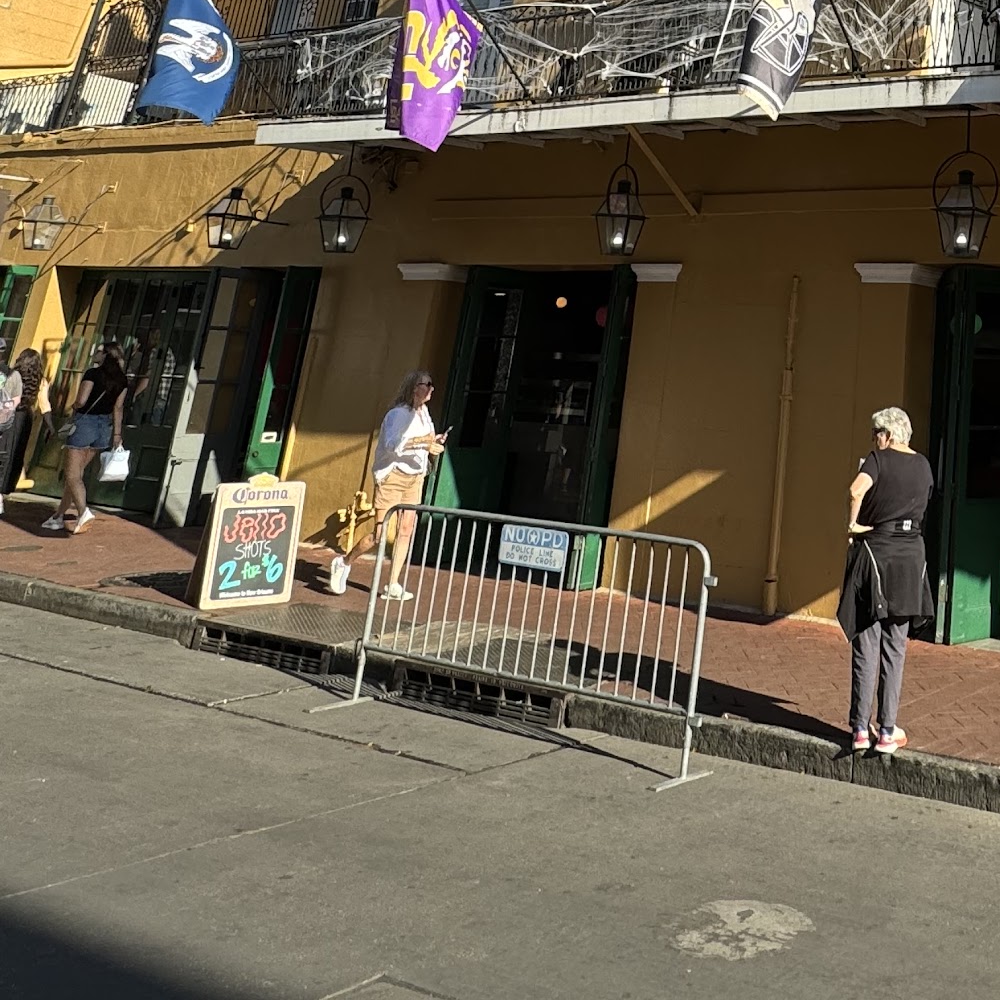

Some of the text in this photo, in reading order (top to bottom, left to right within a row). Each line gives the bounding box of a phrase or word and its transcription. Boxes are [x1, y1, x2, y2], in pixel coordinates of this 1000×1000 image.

[232, 487, 288, 504] Corona
[233, 540, 272, 560] SHOTS
[511, 545, 553, 557] POLICE LINE
[505, 552, 557, 567] DO NOT CROSS
[218, 560, 241, 590] 2
